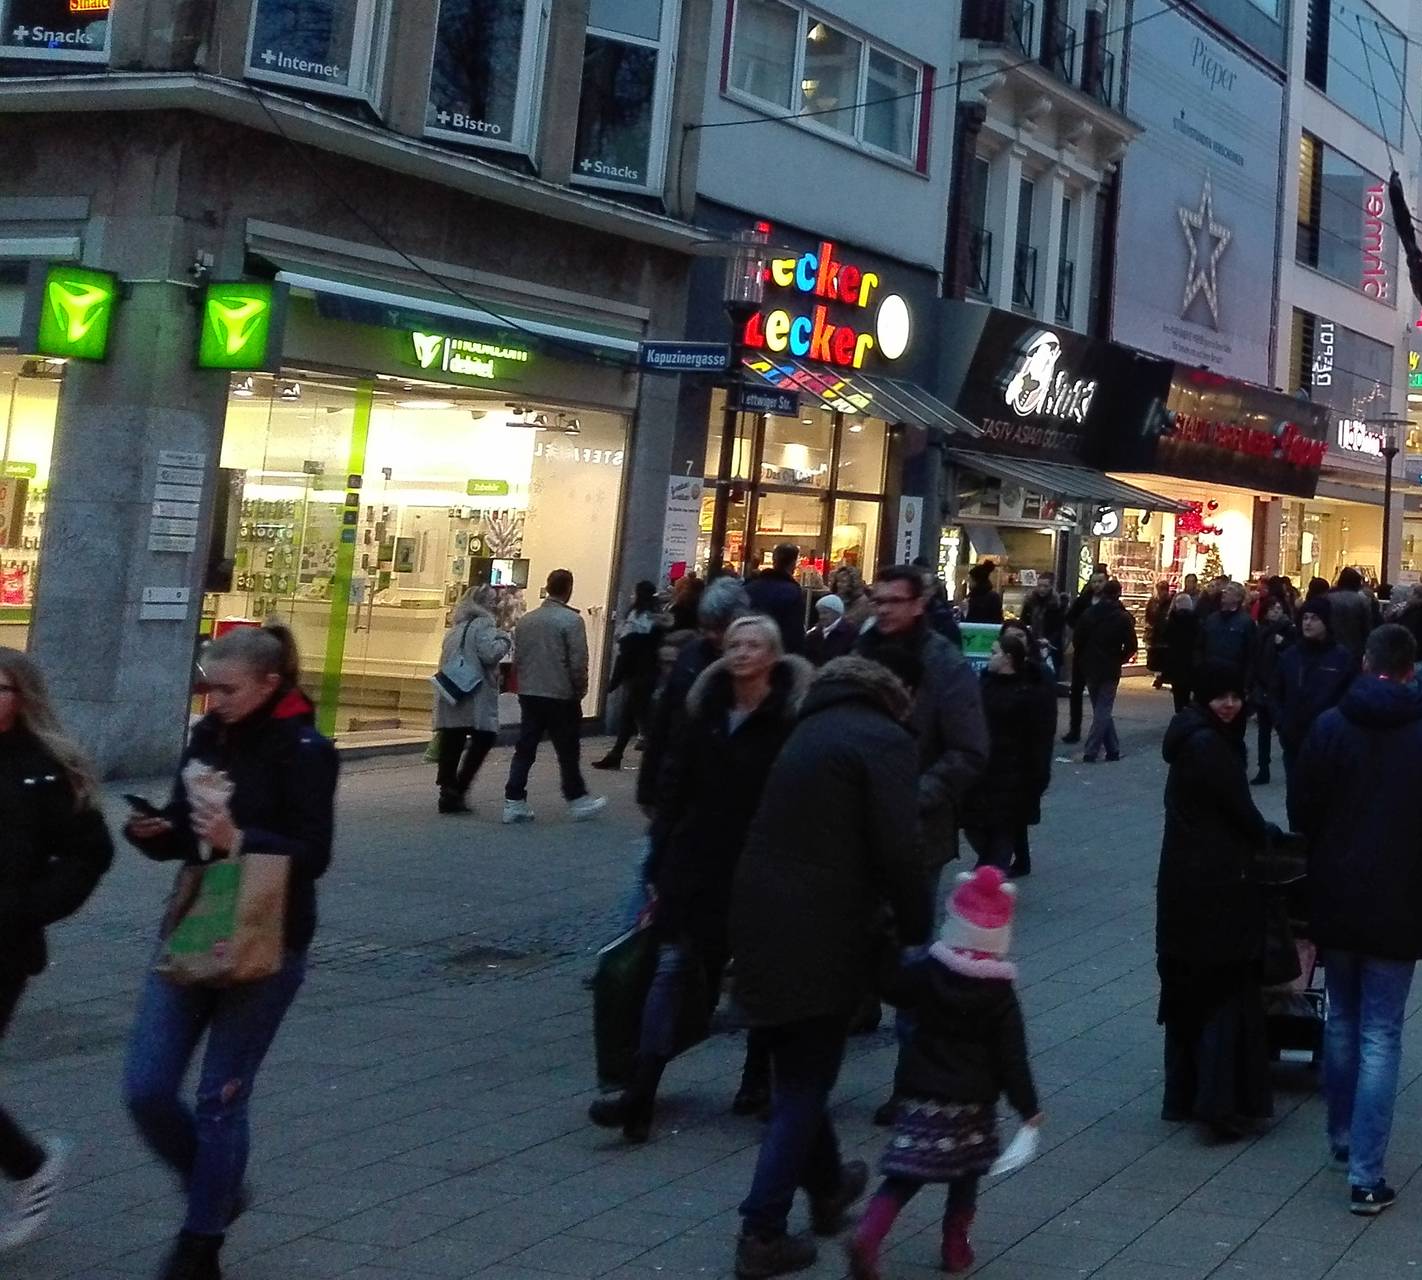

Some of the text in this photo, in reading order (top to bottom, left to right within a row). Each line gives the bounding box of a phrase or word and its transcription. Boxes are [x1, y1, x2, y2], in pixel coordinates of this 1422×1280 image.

[1192, 37, 1237, 90] Pieper
[755, 220, 879, 308] ecker
[647, 348, 726, 368] Kapuzinergasse
[686, 460, 693, 476] 7
